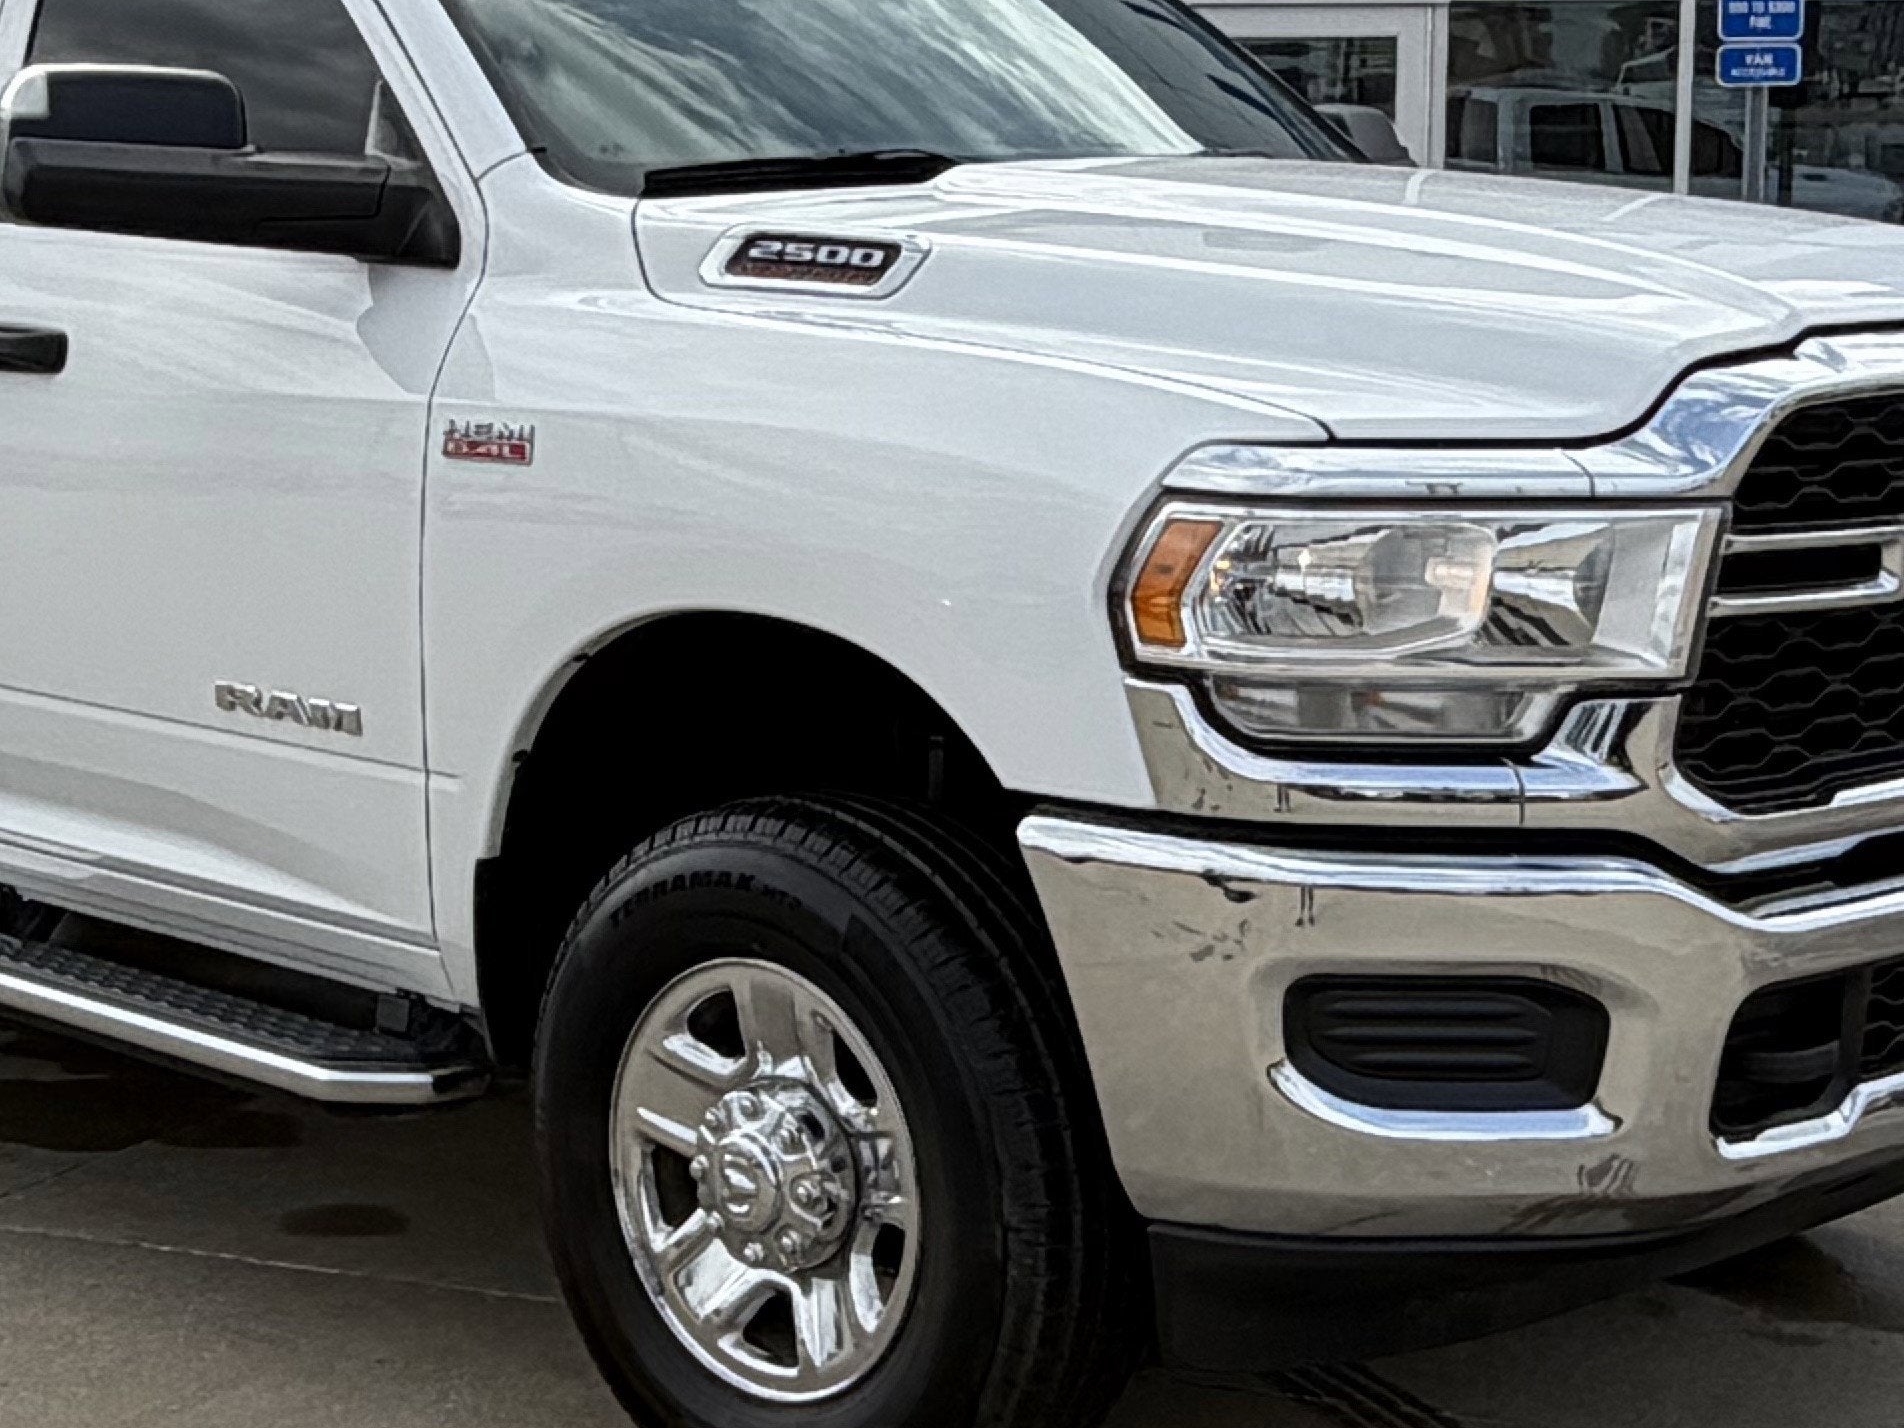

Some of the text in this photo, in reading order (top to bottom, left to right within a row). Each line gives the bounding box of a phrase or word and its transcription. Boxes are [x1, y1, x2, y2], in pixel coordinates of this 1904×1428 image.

[1745, 52, 1774, 66] VAN
[748, 240, 886, 268] 2500
[214, 680, 364, 737] RAM
